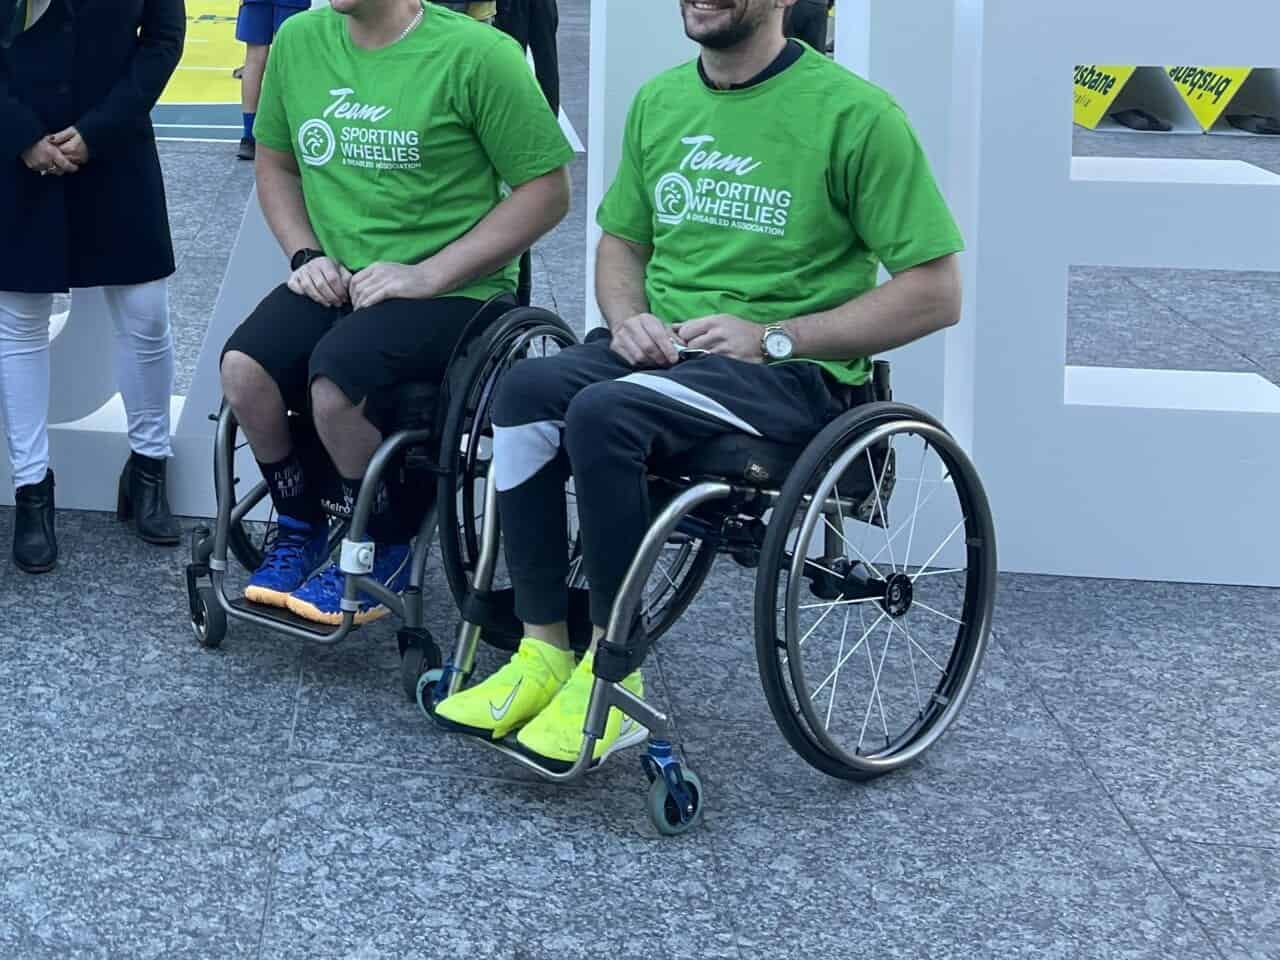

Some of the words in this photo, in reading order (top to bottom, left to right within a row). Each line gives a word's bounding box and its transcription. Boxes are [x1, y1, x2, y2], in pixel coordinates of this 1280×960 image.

[323, 87, 392, 122] Team
[340, 126, 419, 146] SPORTING
[340, 142, 420, 162] WHEELIES
[679, 135, 762, 175] Team
[696, 178, 792, 208] SPORTING
[689, 195, 788, 226] WHEELIES
[692, 213, 730, 226] DISABLED
[731, 220, 785, 237] ASSOCIATION
